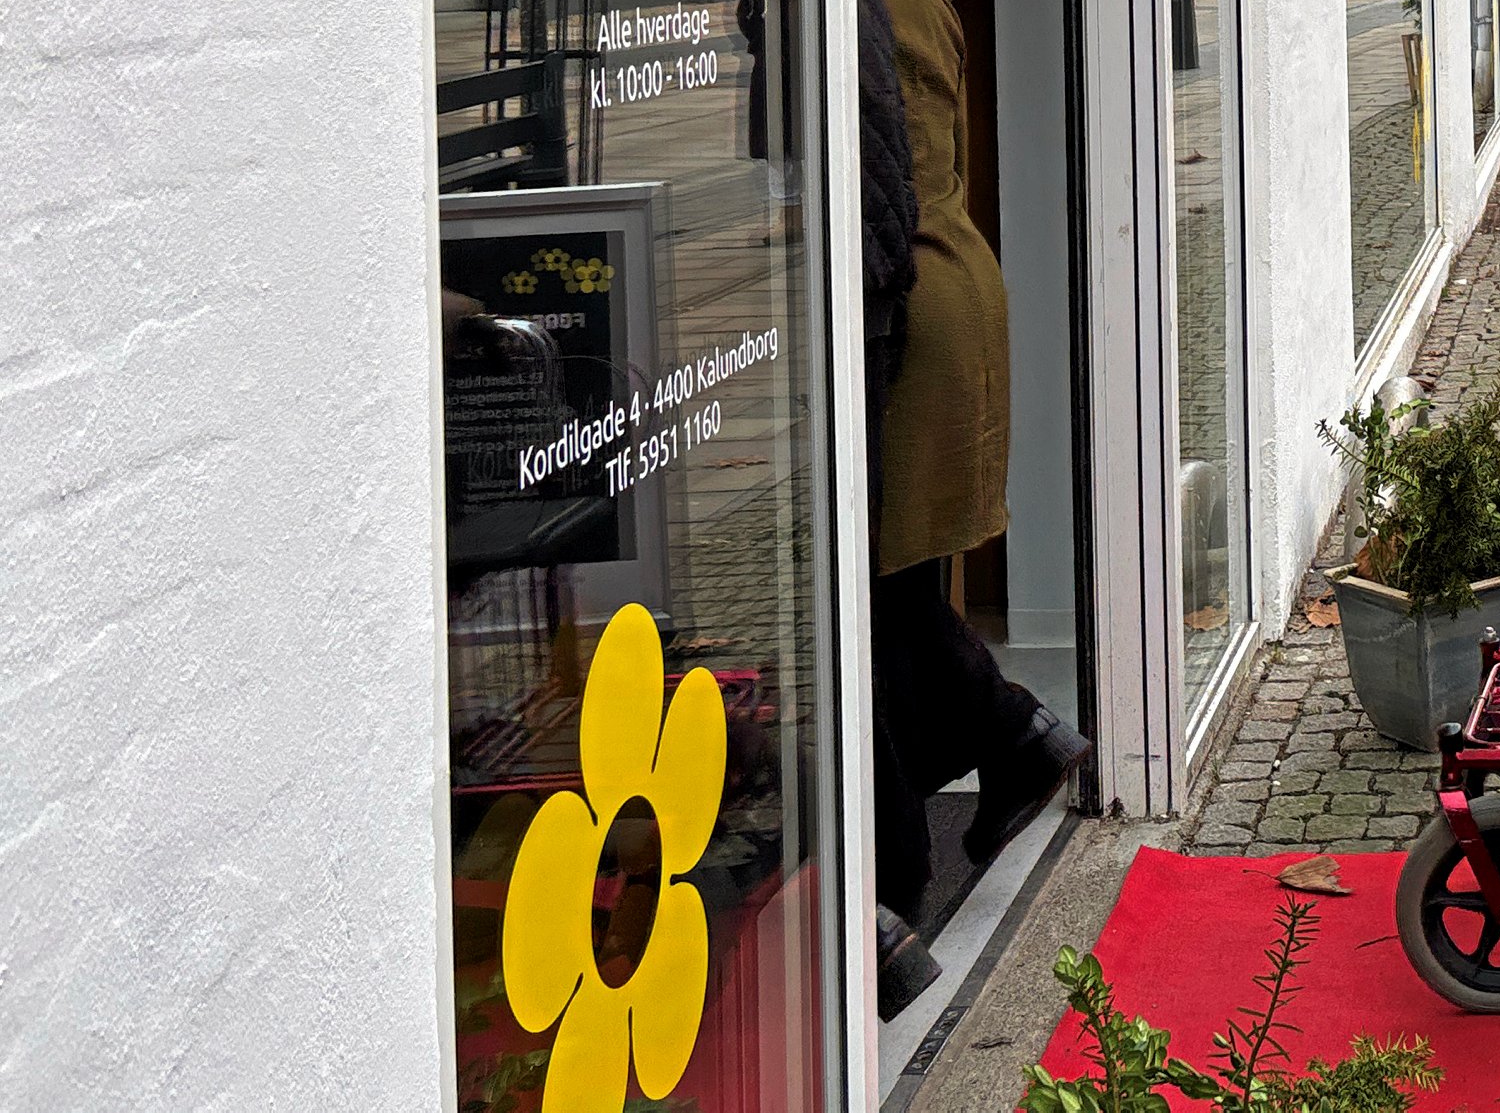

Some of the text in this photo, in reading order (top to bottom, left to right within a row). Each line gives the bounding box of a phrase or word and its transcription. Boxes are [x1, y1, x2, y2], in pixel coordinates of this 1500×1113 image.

[597, 2, 711, 52] Alle hverdage
[590, 68, 612, 110] kl.
[616, 64, 663, 104] 10:00
[676, 50, 718, 91] 16:00
[519, 399, 624, 490] Kordilgade
[629, 391, 641, 428] 4
[652, 363, 694, 415] 4400
[697, 327, 778, 393] Kalundborg
[605, 400, 722, 498] Tlf. 5951 1160
